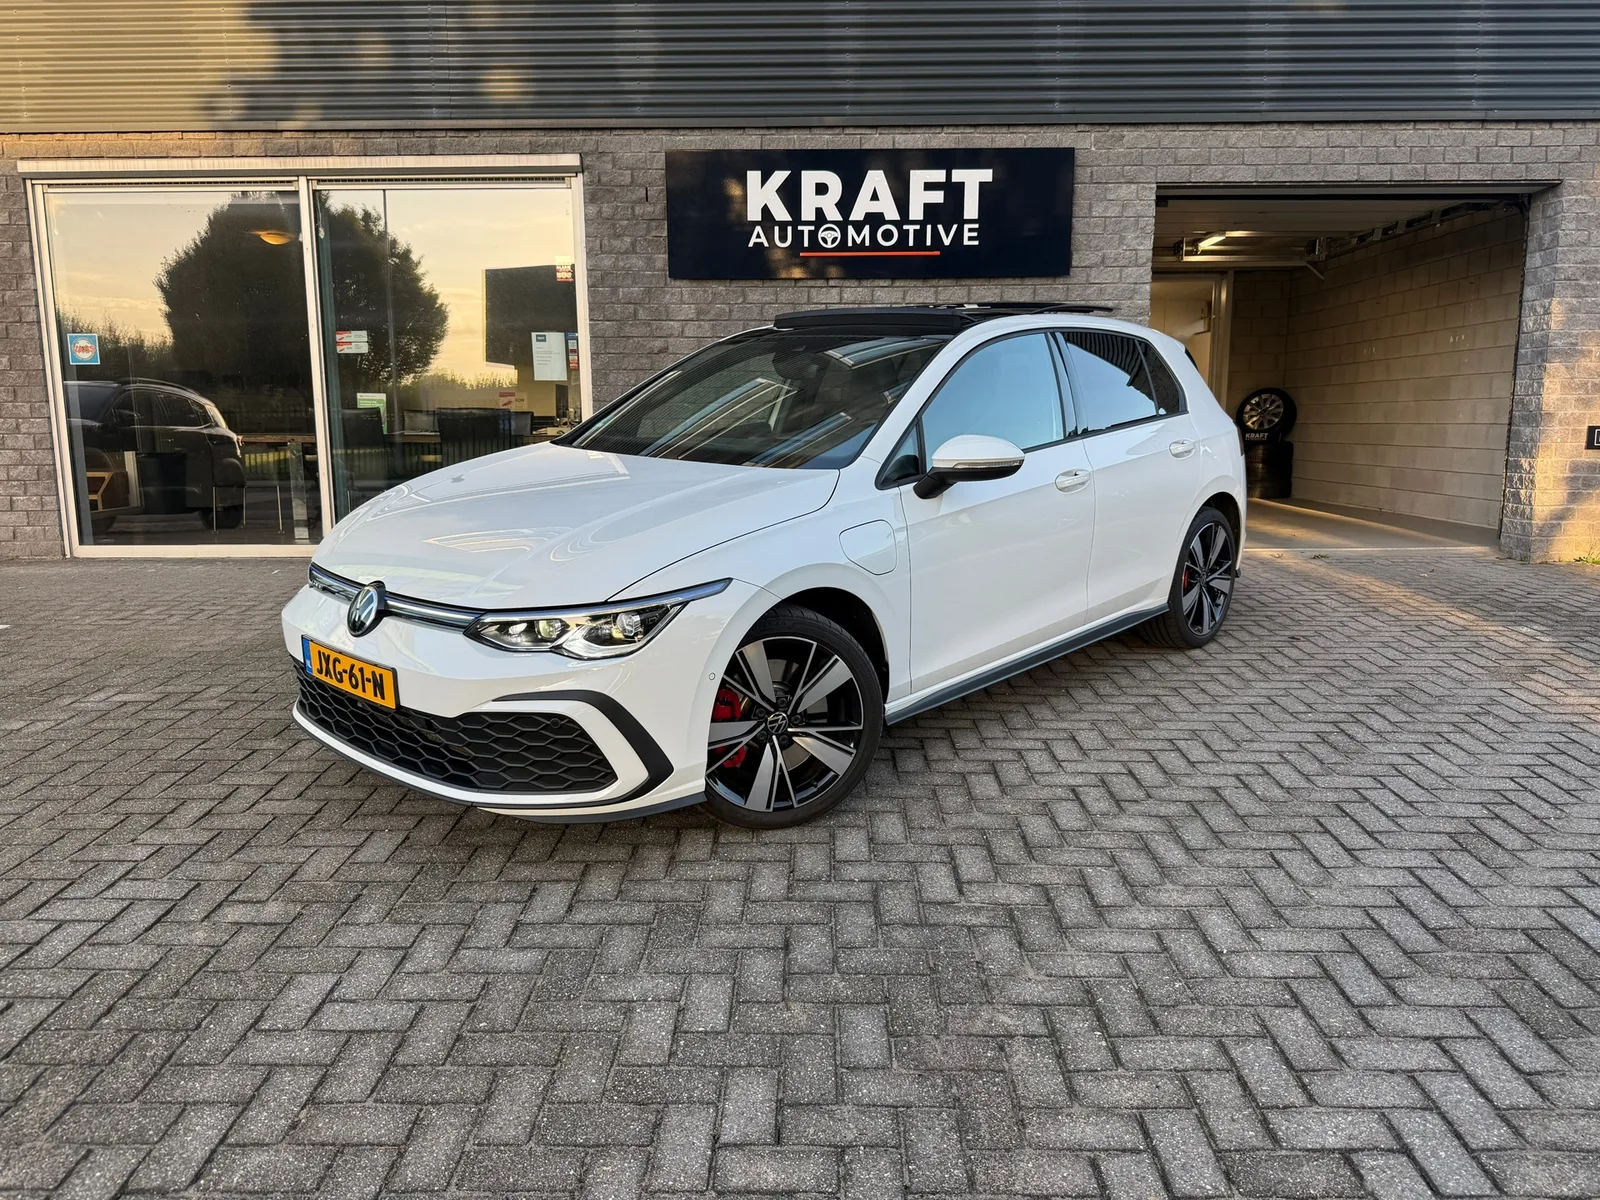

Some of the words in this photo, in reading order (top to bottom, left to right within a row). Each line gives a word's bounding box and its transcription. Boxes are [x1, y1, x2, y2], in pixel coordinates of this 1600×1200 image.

[746, 168, 993, 222] KRAFT
[748, 223, 980, 248] AUTOMOTIVE
[316, 649, 386, 701] JXG-61-N
